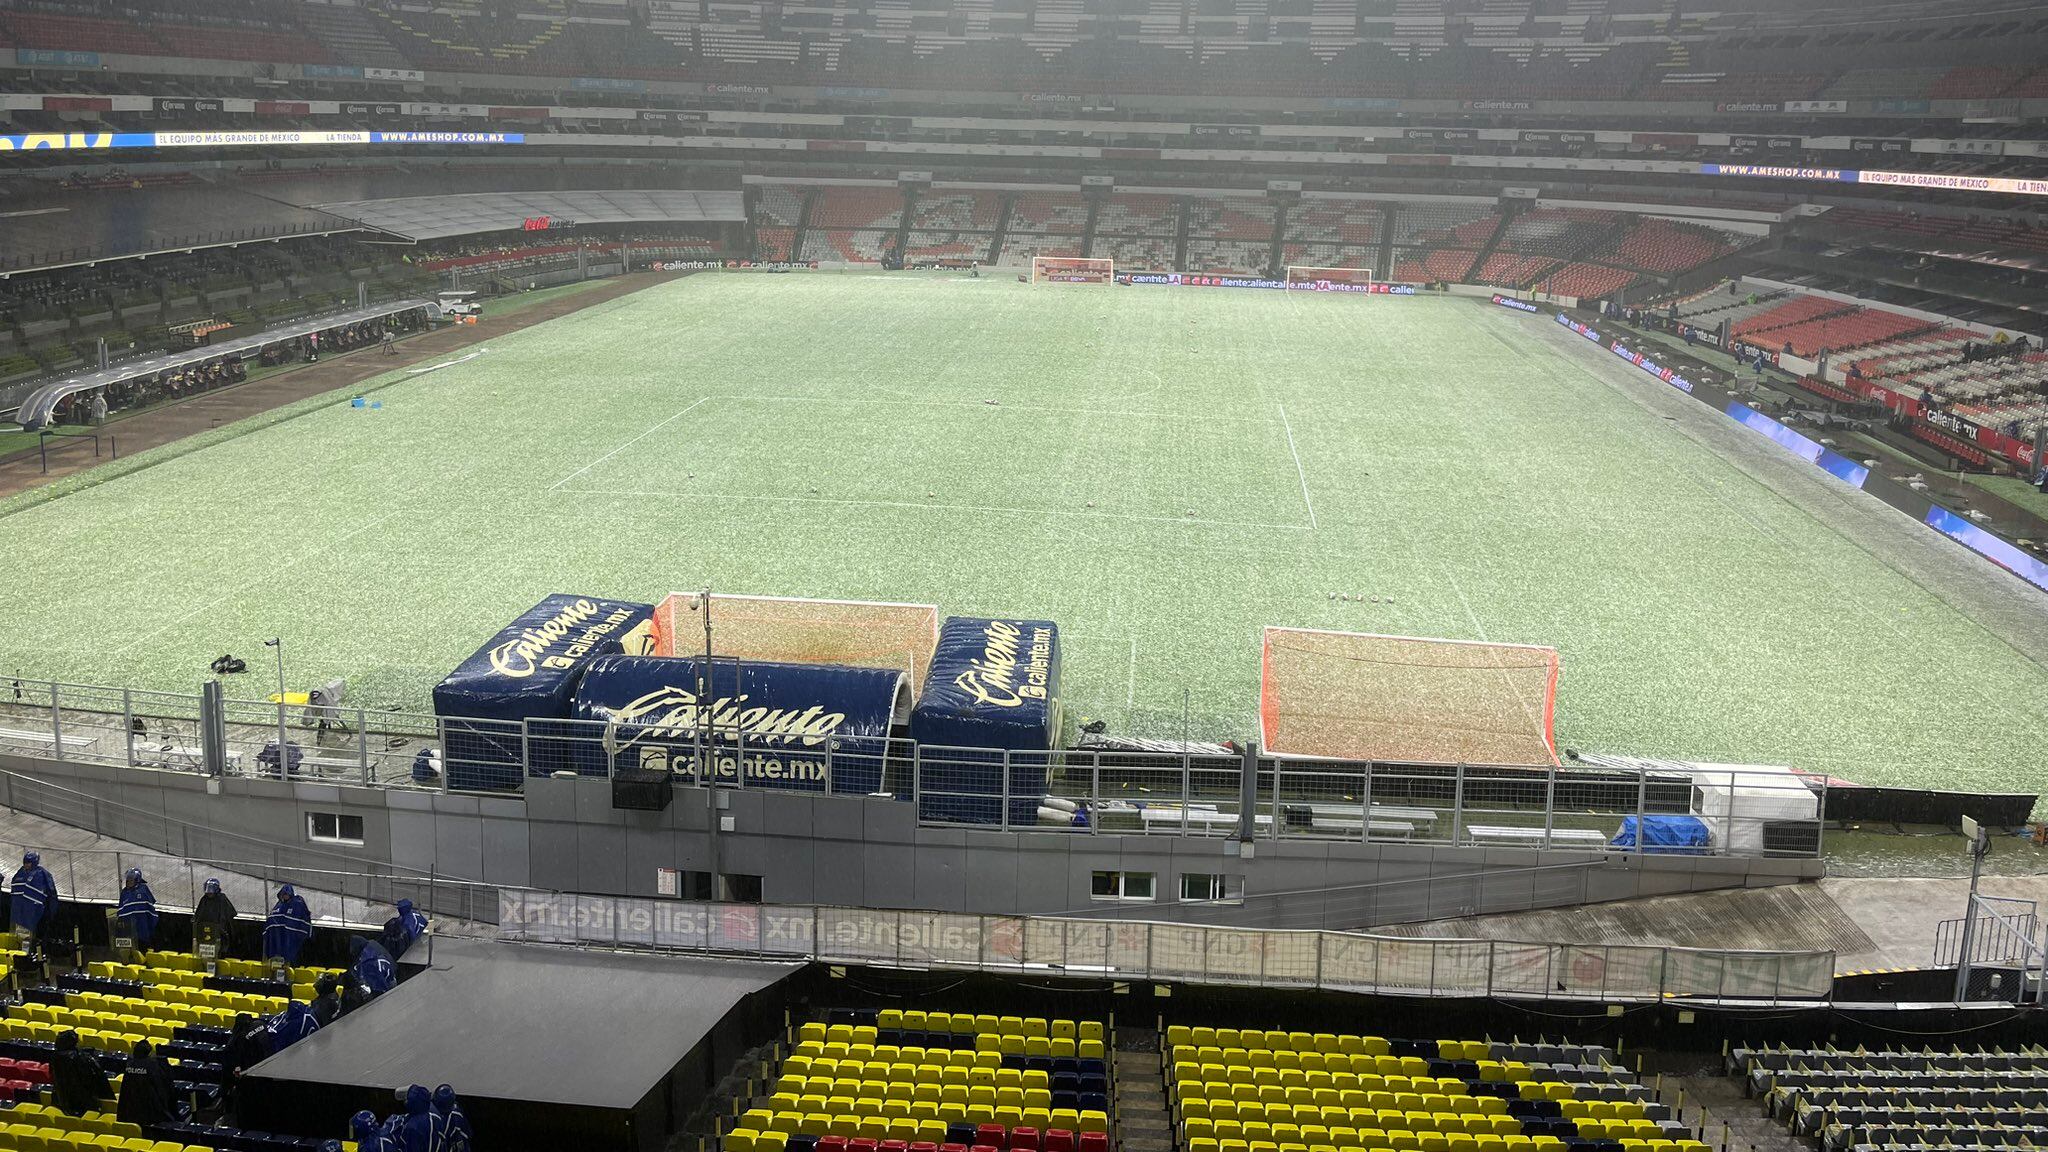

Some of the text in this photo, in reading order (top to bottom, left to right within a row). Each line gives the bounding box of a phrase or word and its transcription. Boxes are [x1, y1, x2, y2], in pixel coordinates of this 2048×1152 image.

[717, 85, 769, 94] caliente.mx
[1031, 94, 1081, 102] caliente.mx
[162, 100, 185, 111] Corona
[195, 101, 217, 111] Corona
[1473, 101, 1529, 110] caliente.mx
[1726, 102, 1778, 112] caliente.mx
[160, 135, 167, 144] EL
[170, 135, 202, 144] EQUIPO
[225, 134, 257, 143] GRANDE
[260, 134, 269, 142] DE
[327, 133, 362, 142] LA TIENDA
[381, 132, 504, 143] WWW.AMESHOP.COM.MX
[1719, 165, 1840, 179] WWW.AMESHOP.COM.MX
[1872, 174, 1898, 182] EQUIPO
[1918, 176, 1947, 186] GRANDE
[1949, 177, 1958, 187] DE
[2018, 181, 2027, 191] LA
[664, 260, 722, 271] caliente.mx
[751, 261, 808, 270] caliente.mx
[1500, 298, 1537, 312] caliente.mx
[484, 599, 598, 677] Caliente
[564, 607, 634, 658] caliente.mx
[1027, 627, 1050, 686] caliente.mx
[954, 621, 1022, 707] Caliente
[602, 685, 846, 754] Caliente
[672, 753, 829, 781] caliente.mx
